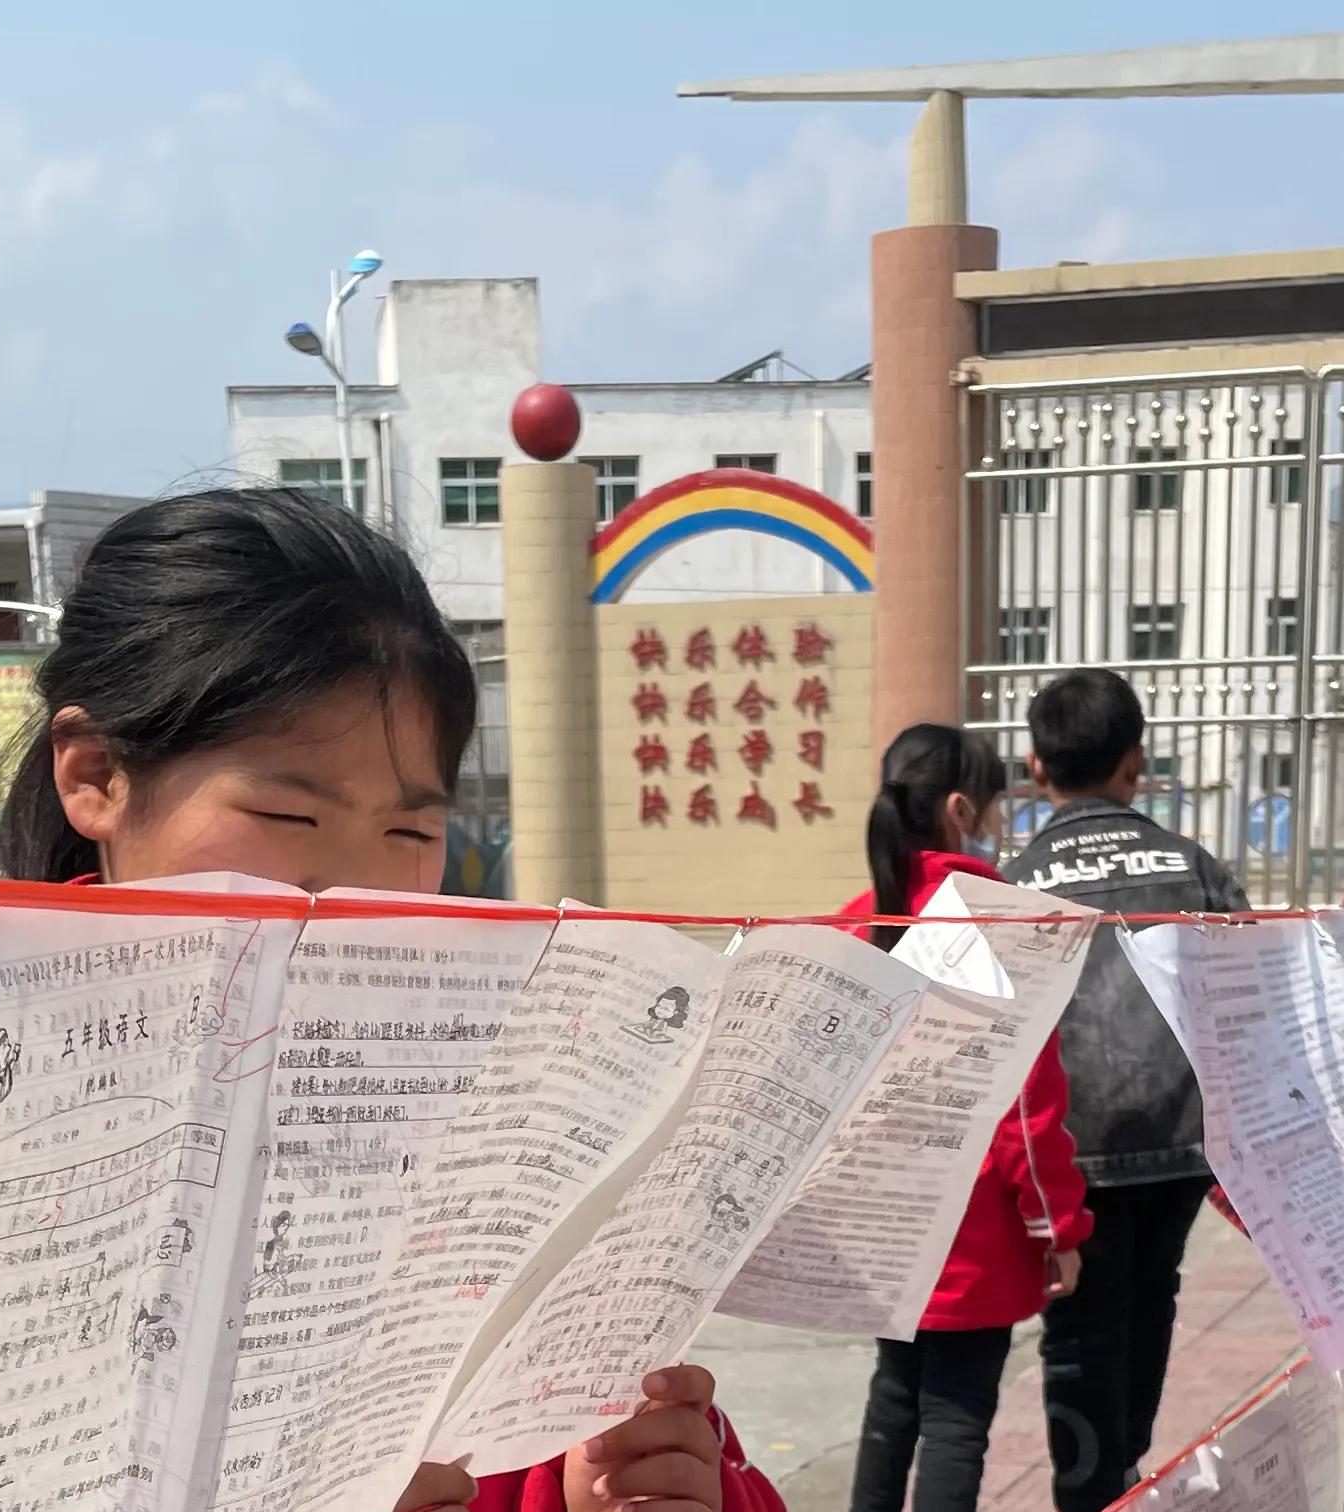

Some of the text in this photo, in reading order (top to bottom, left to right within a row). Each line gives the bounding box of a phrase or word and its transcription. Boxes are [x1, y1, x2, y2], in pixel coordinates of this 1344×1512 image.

[630, 676, 833, 726] 快乐合作
[632, 729, 829, 777] 快乐学习
[638, 781, 835, 832] 快乐成长
[61, 1006, 150, 1059] 五年级语文
